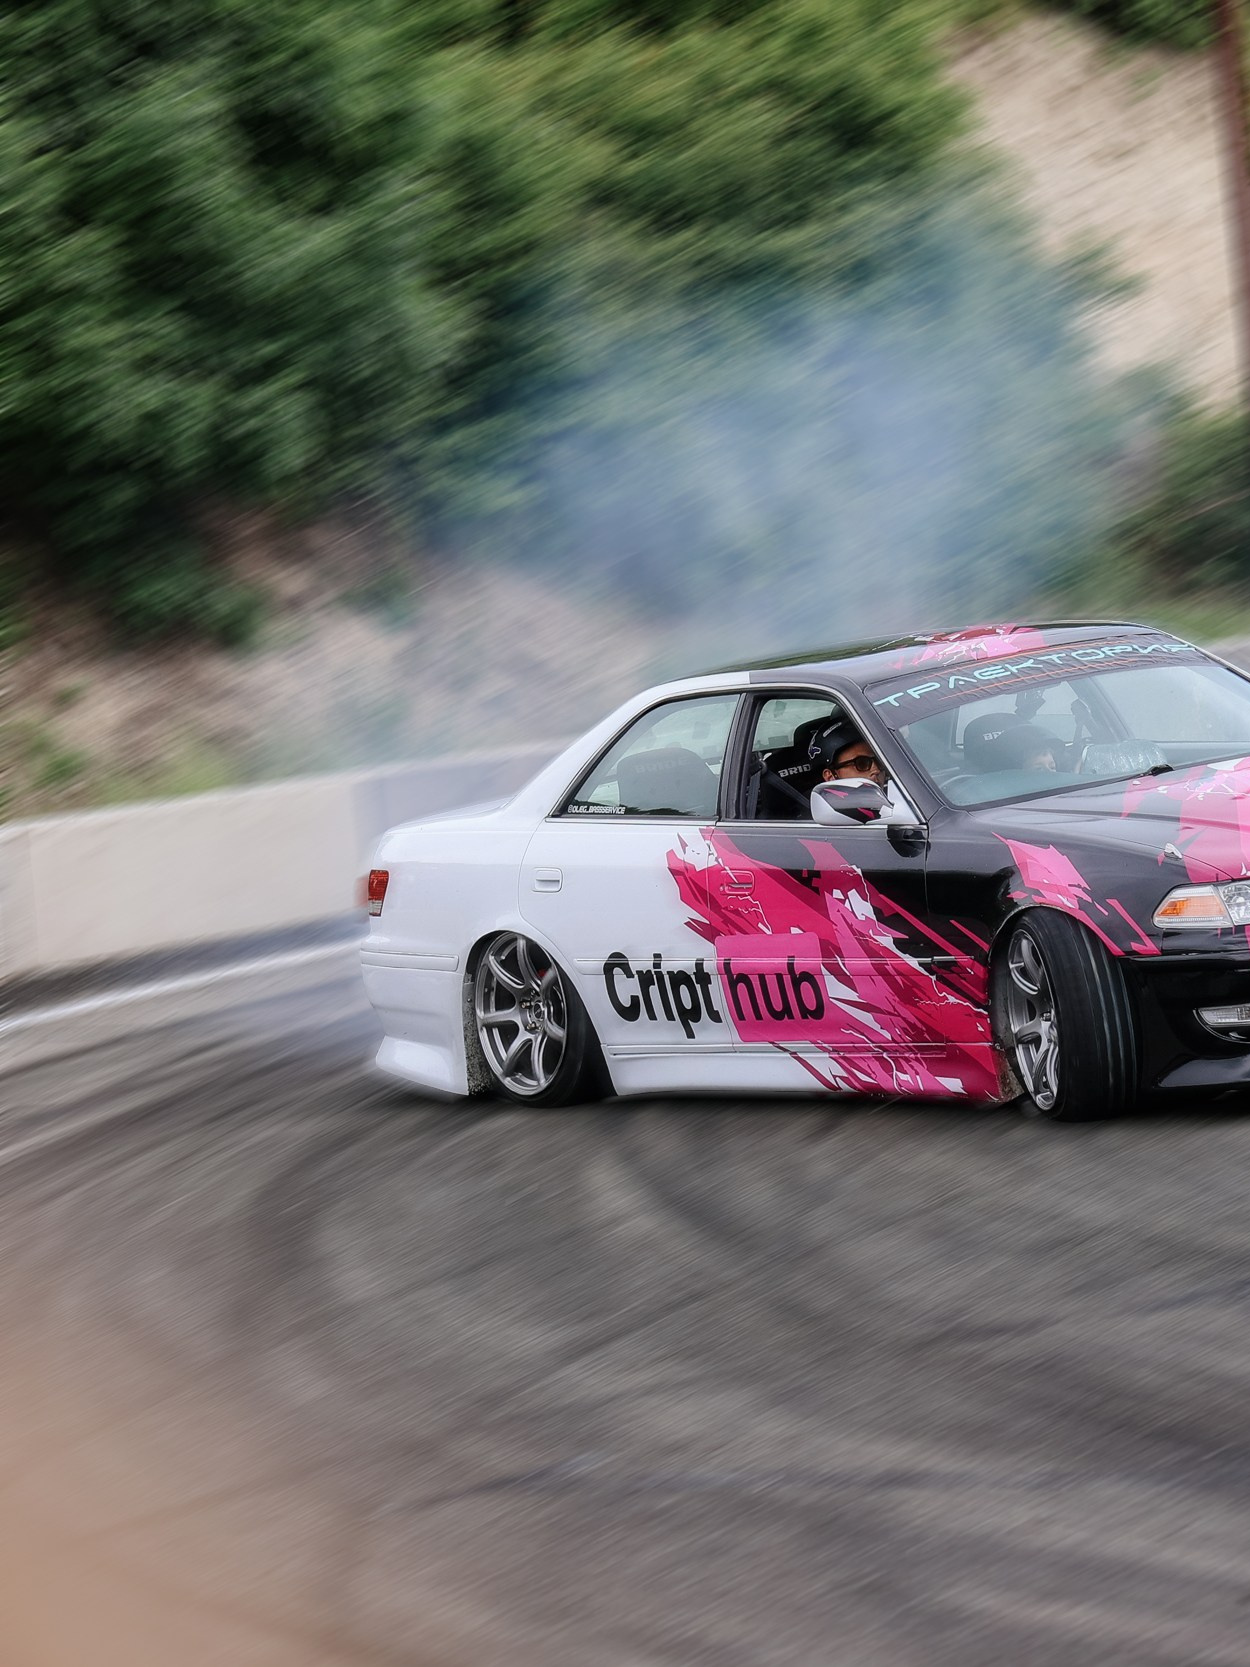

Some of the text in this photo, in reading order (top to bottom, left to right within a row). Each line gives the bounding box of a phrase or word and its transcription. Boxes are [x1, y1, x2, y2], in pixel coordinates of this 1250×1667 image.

[778, 763, 812, 778] BRID
[602, 951, 825, 1040] Cript hub
